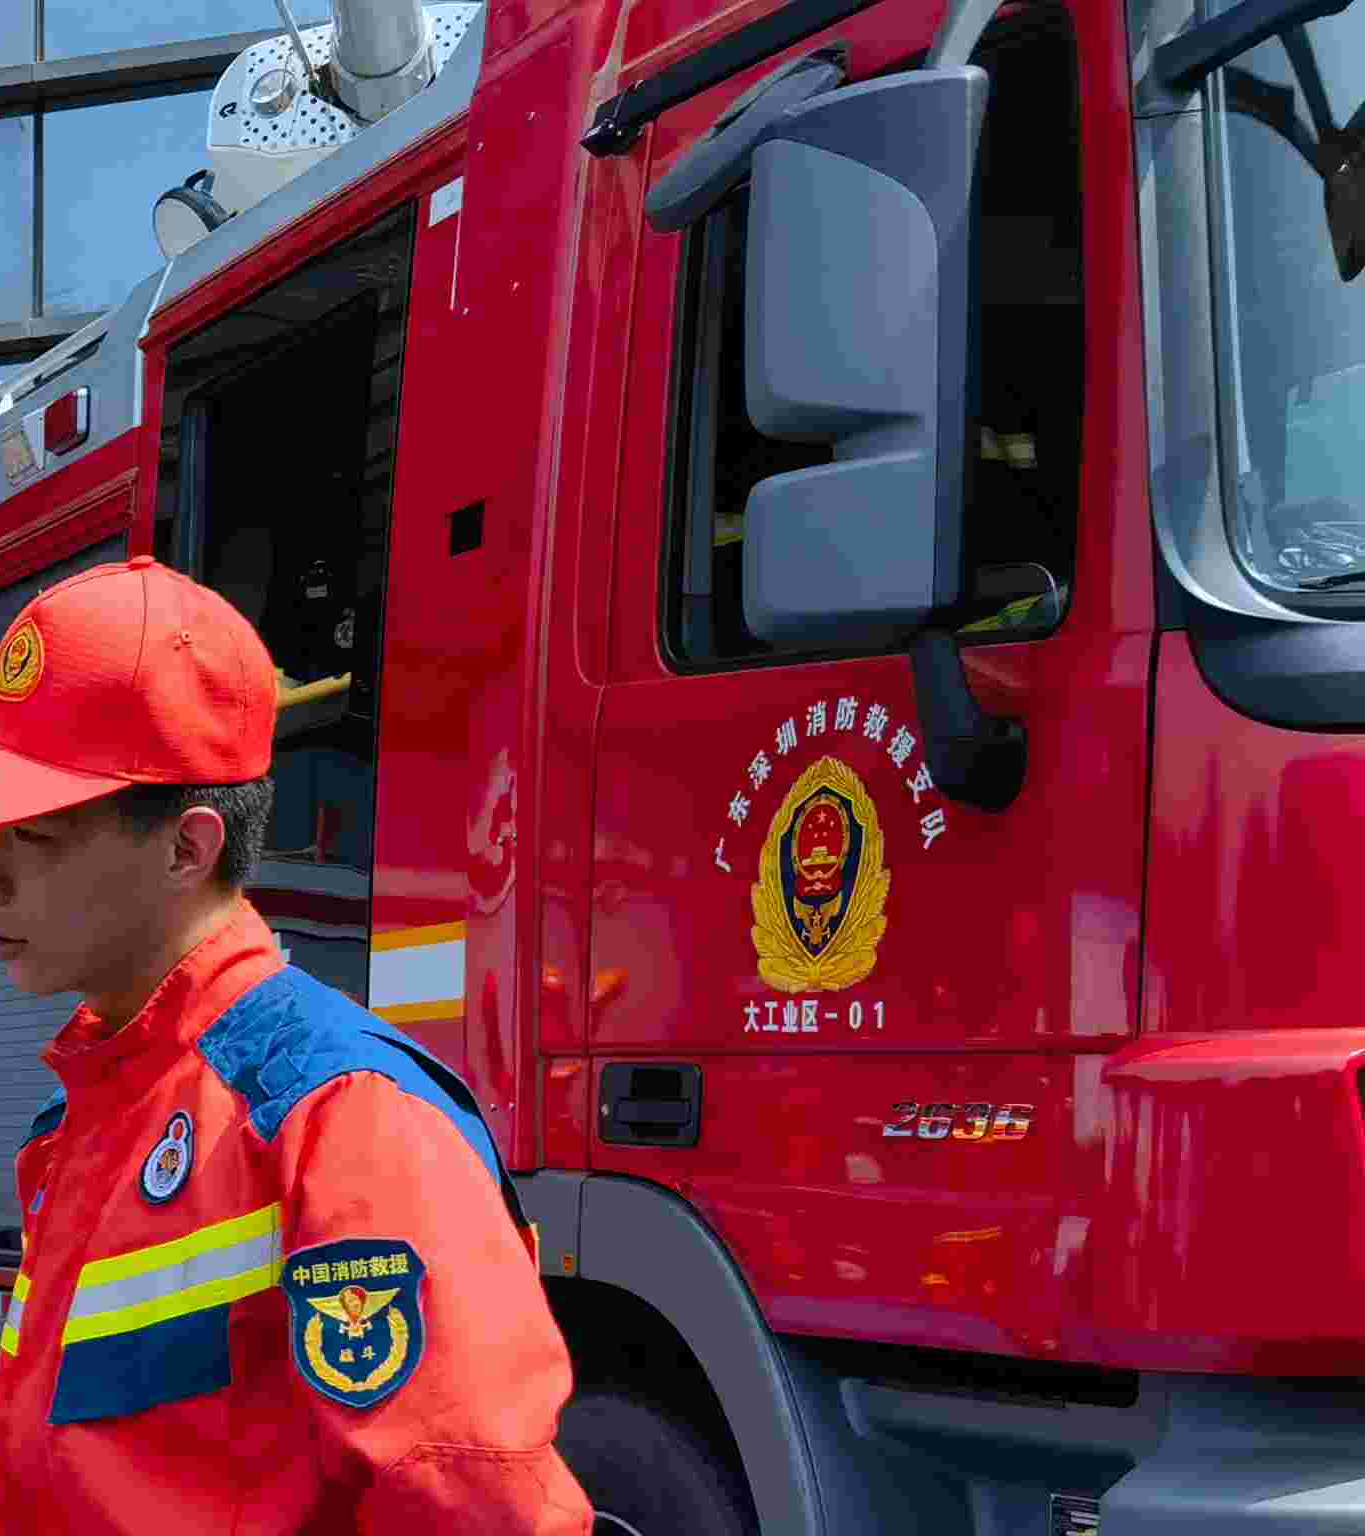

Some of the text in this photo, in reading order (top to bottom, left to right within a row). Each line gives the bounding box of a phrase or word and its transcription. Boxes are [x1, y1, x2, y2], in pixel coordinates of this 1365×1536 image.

[714, 695, 947, 873] 广东深圳消防救援支队
[743, 1000, 886, 1034] 大工业区-01
[292, 1252, 409, 1287] 中国消防救援
